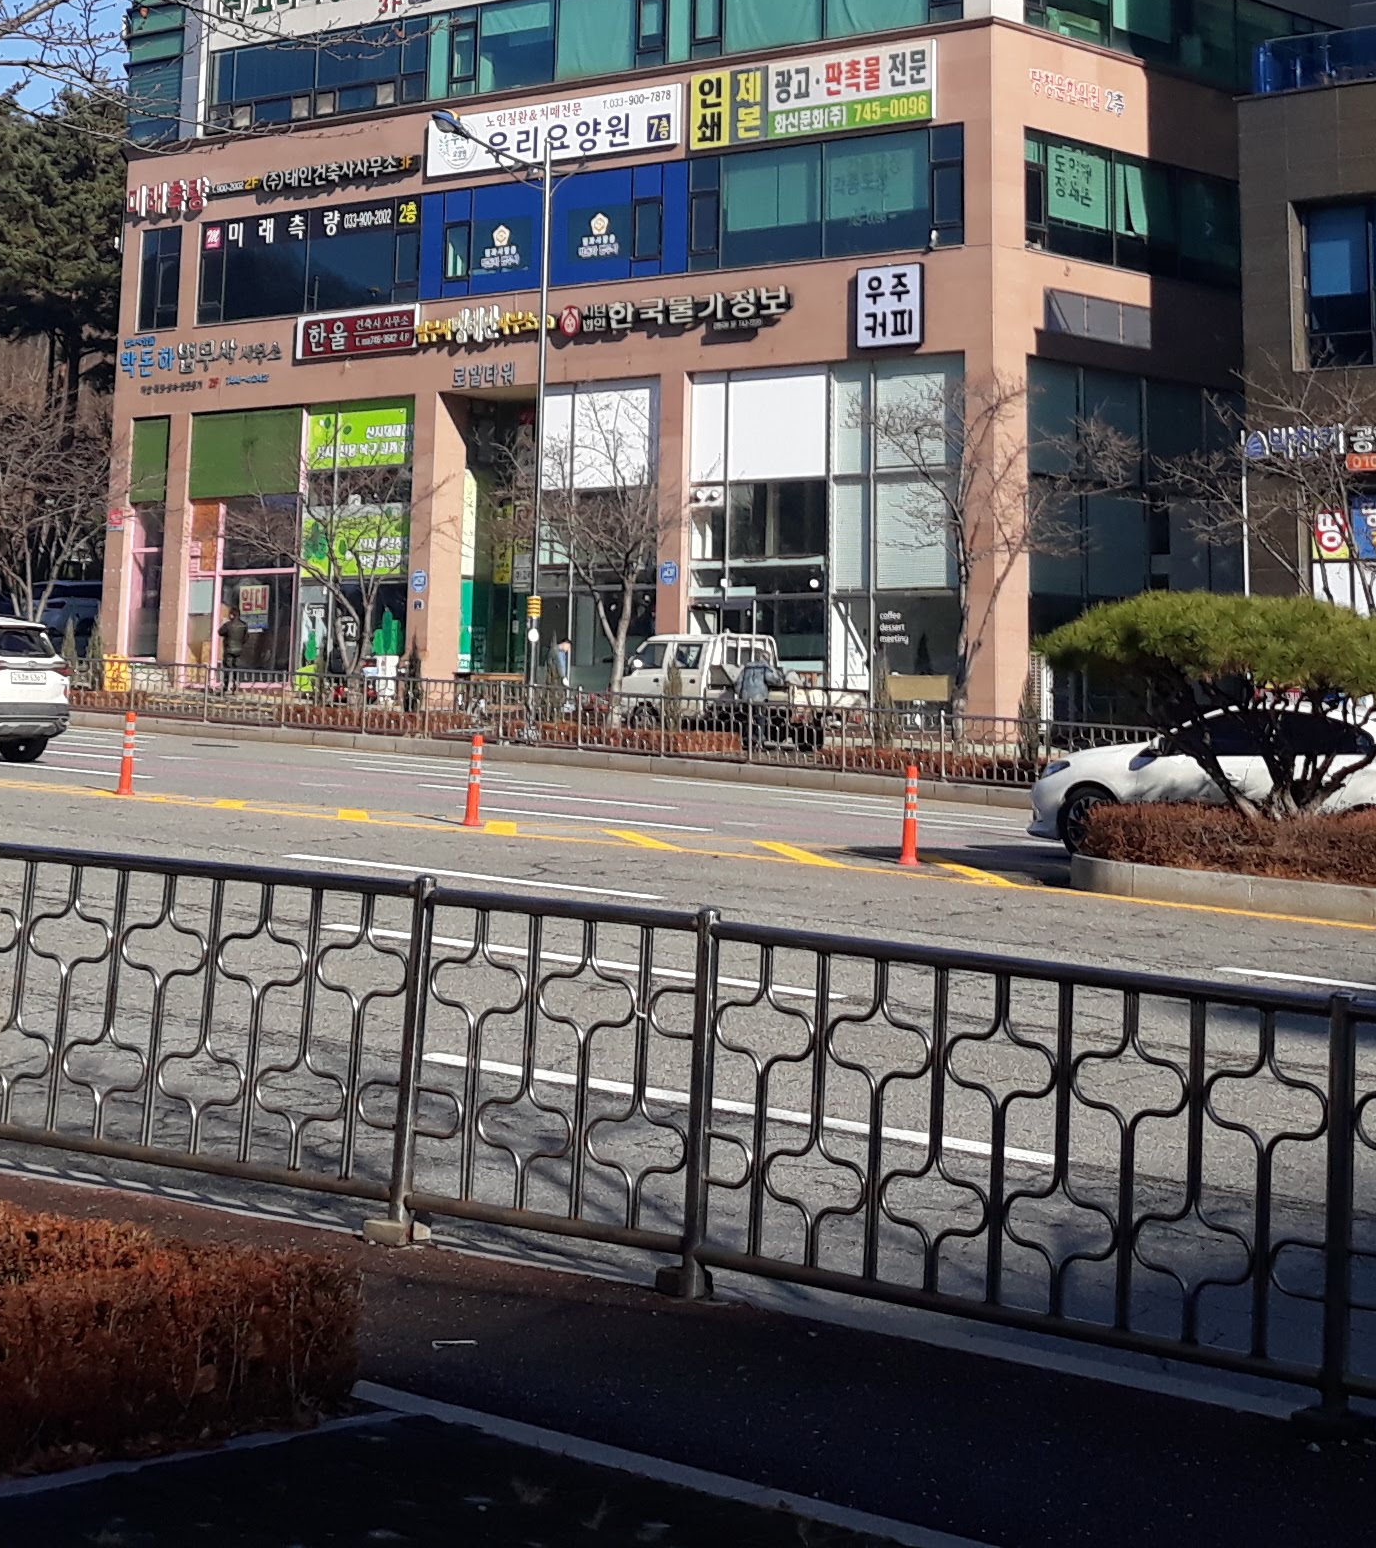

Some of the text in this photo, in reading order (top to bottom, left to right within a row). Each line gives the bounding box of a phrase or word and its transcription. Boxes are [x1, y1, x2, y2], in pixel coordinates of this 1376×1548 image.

[485, 89, 672, 128] 노인질환&치매전문 T.033-900-7878
[696, 48, 927, 143] 인쇄 광고 판촉물 전문
[773, 95, 928, 135] 화신문화(주) 745-0096
[484, 113, 671, 160] 우리요양원 7층
[244, 175, 261, 190] 2F
[343, 208, 393, 230] 033-900-2002
[399, 201, 418, 225] 2층
[863, 270, 912, 307] 우주
[609, 285, 788, 330] 한국물가정보
[863, 307, 914, 340] 커피
[308, 321, 349, 353] 한울
[241, 587, 268, 612] 임대
